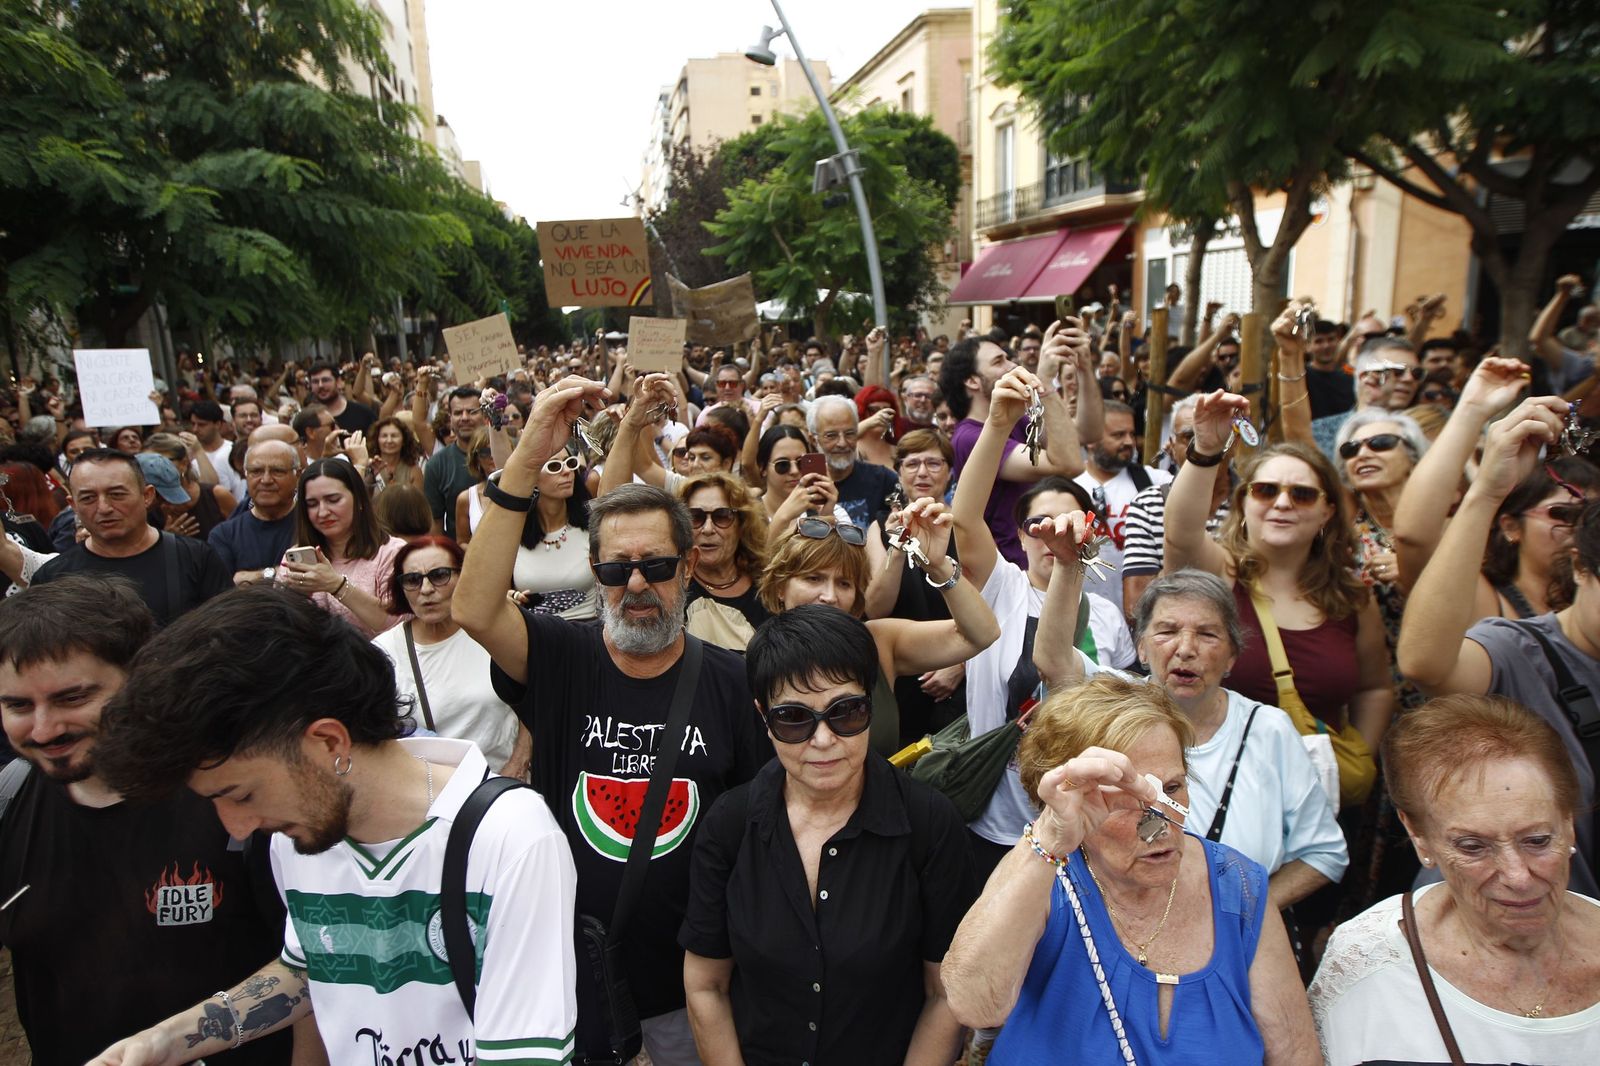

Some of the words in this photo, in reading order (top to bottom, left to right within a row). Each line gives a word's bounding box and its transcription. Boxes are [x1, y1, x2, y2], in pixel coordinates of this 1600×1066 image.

[551, 223, 589, 242] QUE
[600, 222, 622, 238] LA
[555, 243, 634, 260] VIVIENDA
[551, 262, 577, 277] NO
[585, 260, 617, 275] SEA
[623, 258, 646, 274] UN
[571, 276, 627, 297] LUJO
[454, 326, 480, 344] SER
[457, 351, 474, 364] NO
[481, 346, 493, 357] ES
[497, 341, 512, 350] UNA
[163, 886, 207, 906] IDLE
[160, 904, 210, 923] FURY
